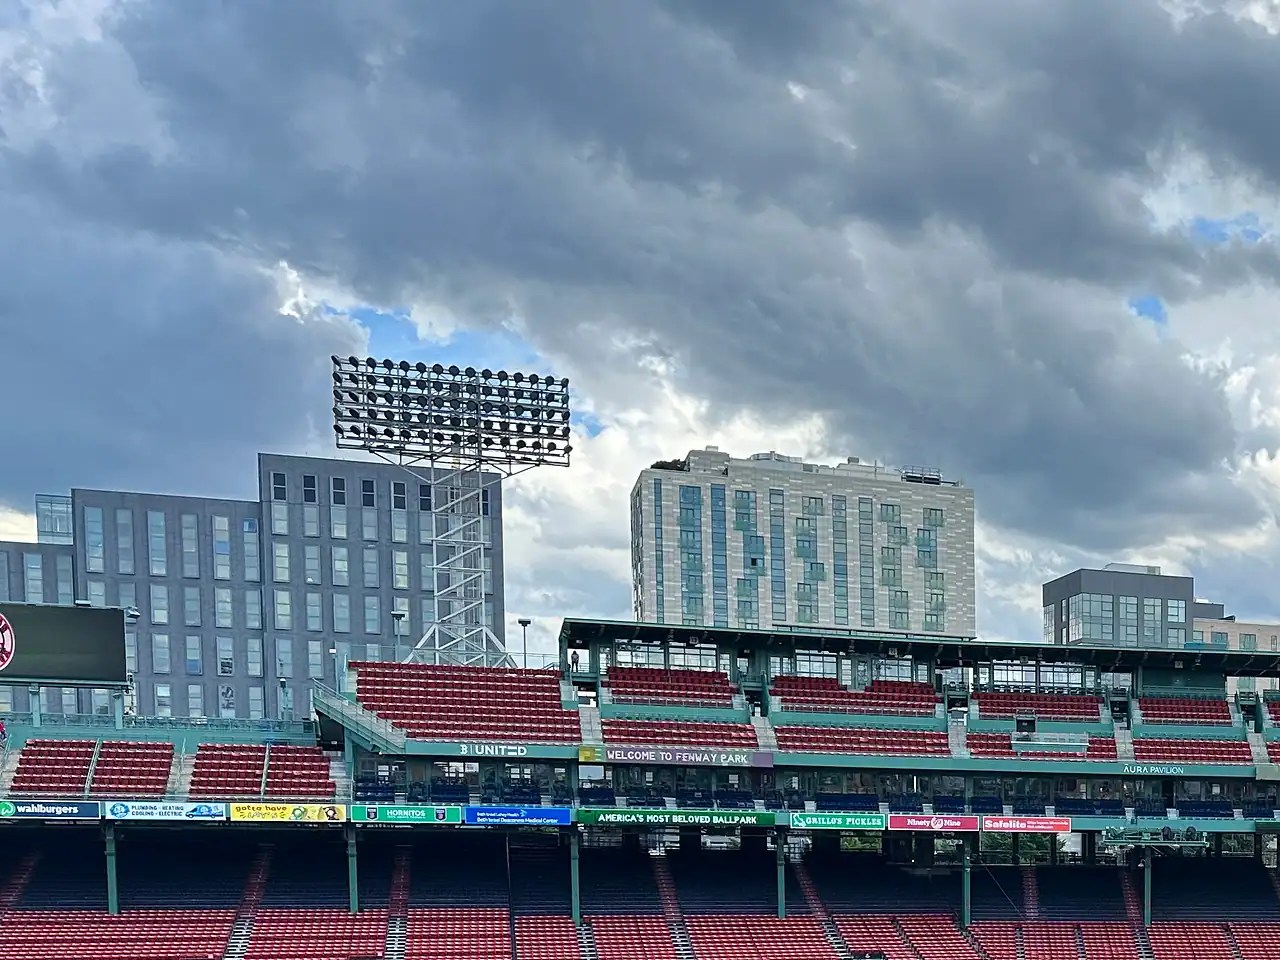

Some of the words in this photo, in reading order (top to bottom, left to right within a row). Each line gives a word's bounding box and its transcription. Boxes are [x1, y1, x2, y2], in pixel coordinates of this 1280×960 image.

[475, 744, 527, 756] UNITED
[607, 750, 655, 761] WELCOME
[660, 751, 672, 761] TO
[676, 752, 716, 763] FENWAY
[720, 753, 747, 764] PARK
[1150, 766, 1184, 774] PAVILION
[16, 804, 79, 815] wahlburgers
[386, 809, 426, 817] HORNITOS
[598, 813, 644, 823] AMERICA'S
[646, 814, 669, 823] MOST
[672, 815, 711, 824] BELOVED
[712, 815, 757, 825] BALLPARK
[805, 817, 842, 825] GRILLO'S
[846, 817, 882, 826] PICKLES
[907, 818, 930, 827] Ninety
[985, 820, 1026, 829] Safelite
